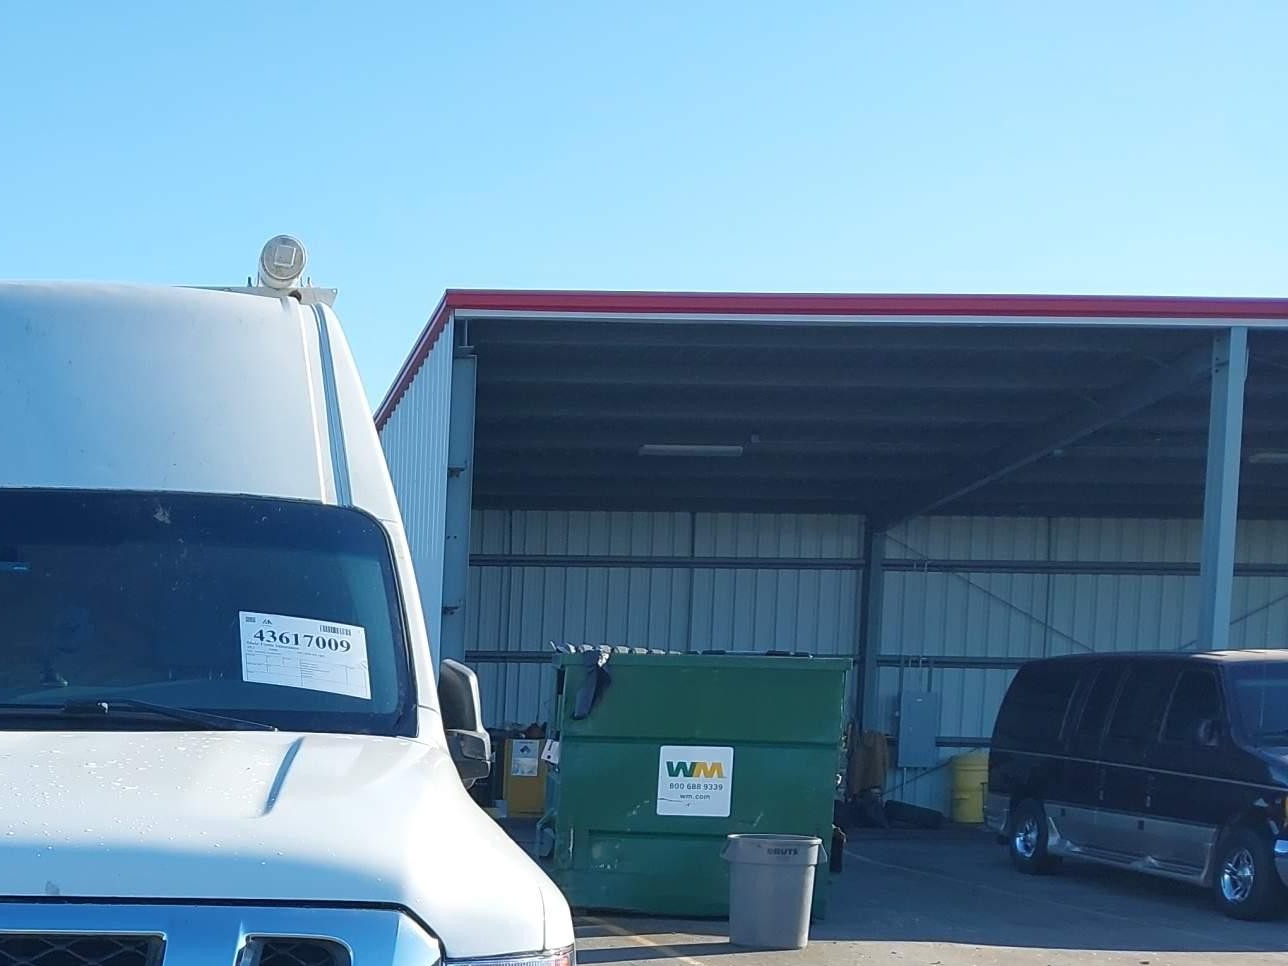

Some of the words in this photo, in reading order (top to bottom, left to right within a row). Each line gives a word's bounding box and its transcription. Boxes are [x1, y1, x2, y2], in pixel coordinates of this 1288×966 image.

[253, 629, 351, 652] 43617009
[666, 761, 724, 779] WM
[703, 783, 723, 791] 9339
